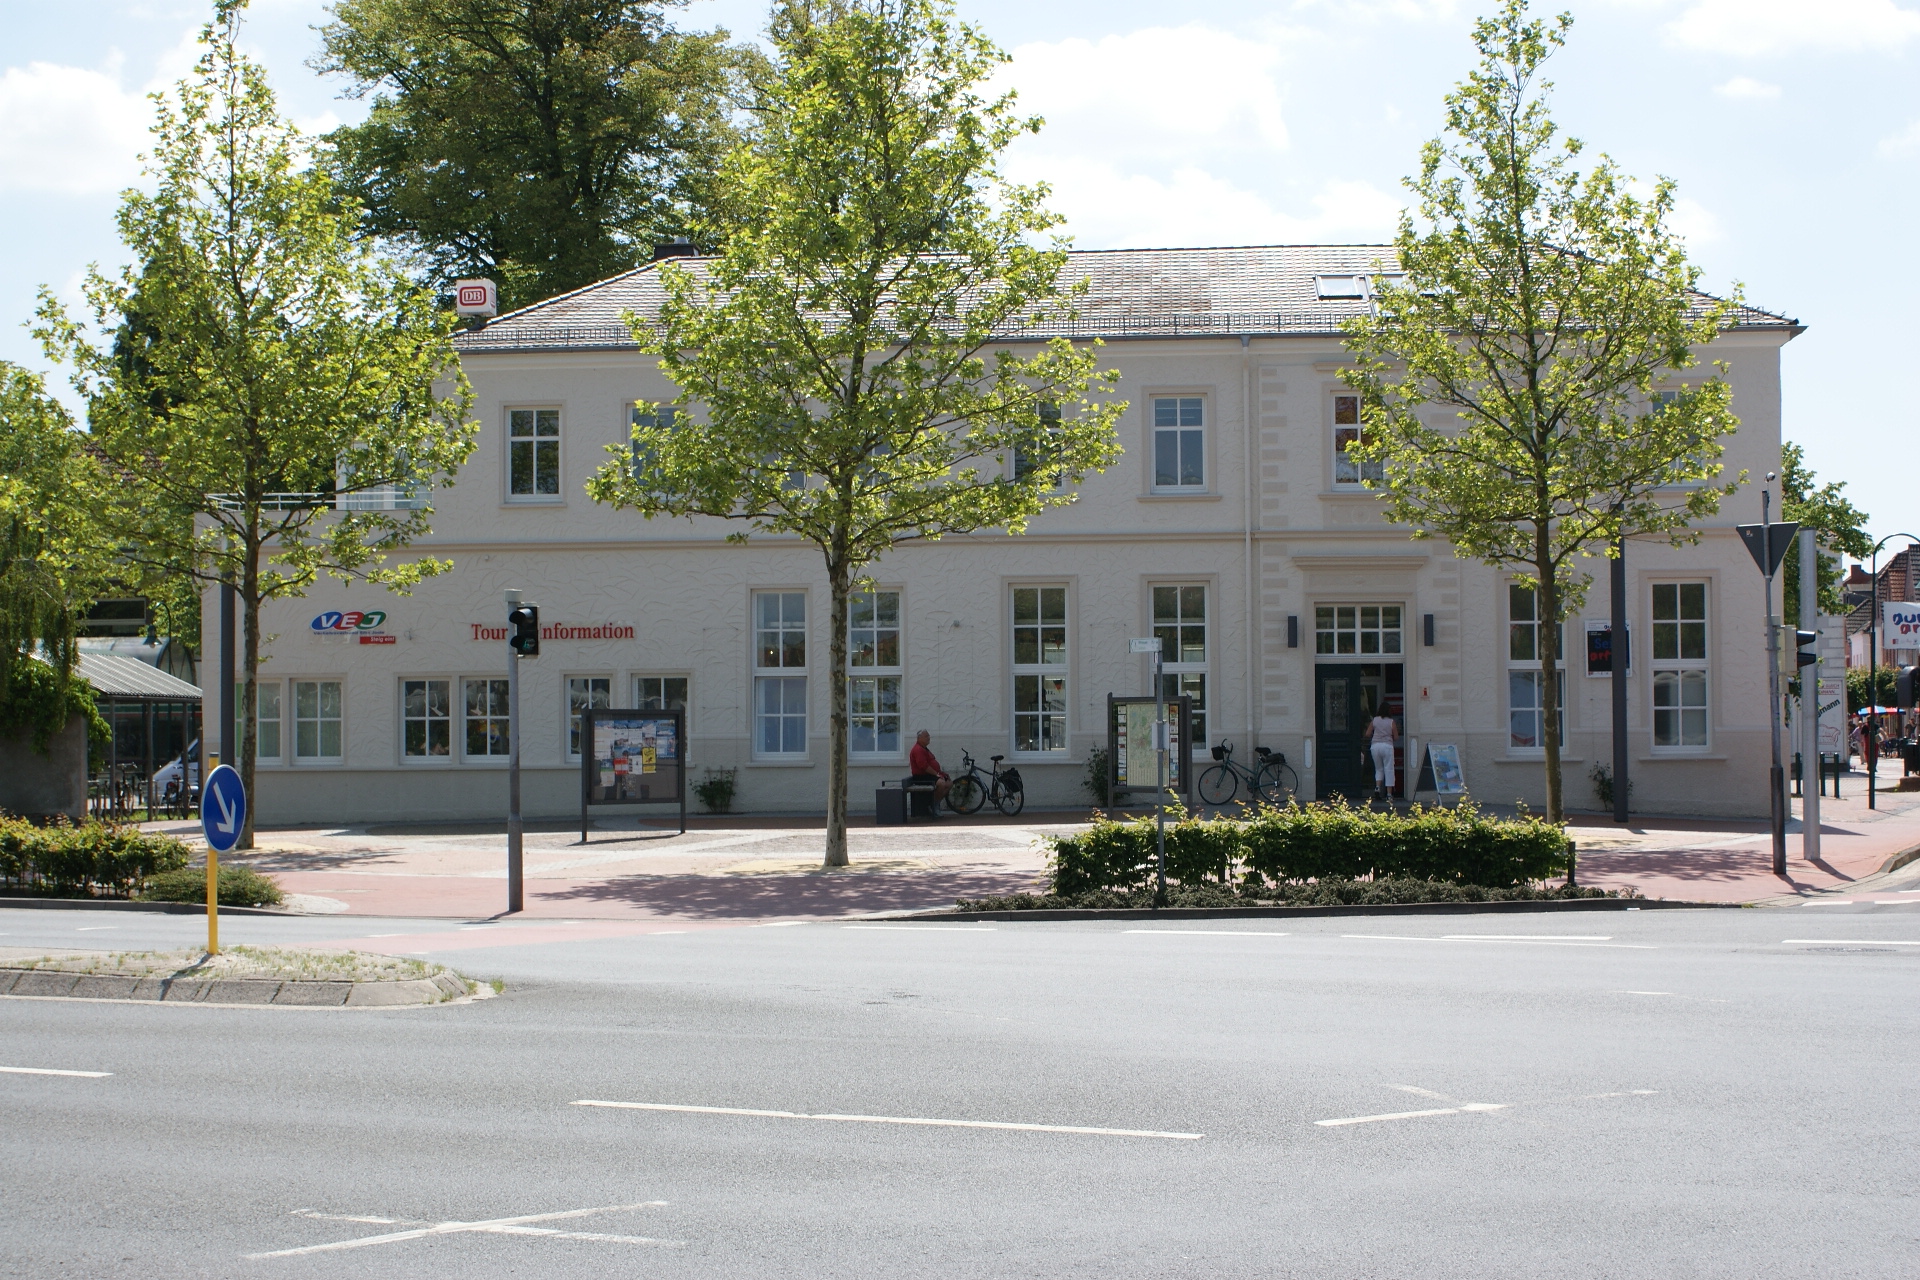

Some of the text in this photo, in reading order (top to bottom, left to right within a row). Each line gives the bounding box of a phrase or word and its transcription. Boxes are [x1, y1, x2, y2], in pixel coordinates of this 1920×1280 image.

[465, 291, 482, 301] DB
[320, 614, 382, 628] VEJ
[471, 623, 509, 641] Tour
